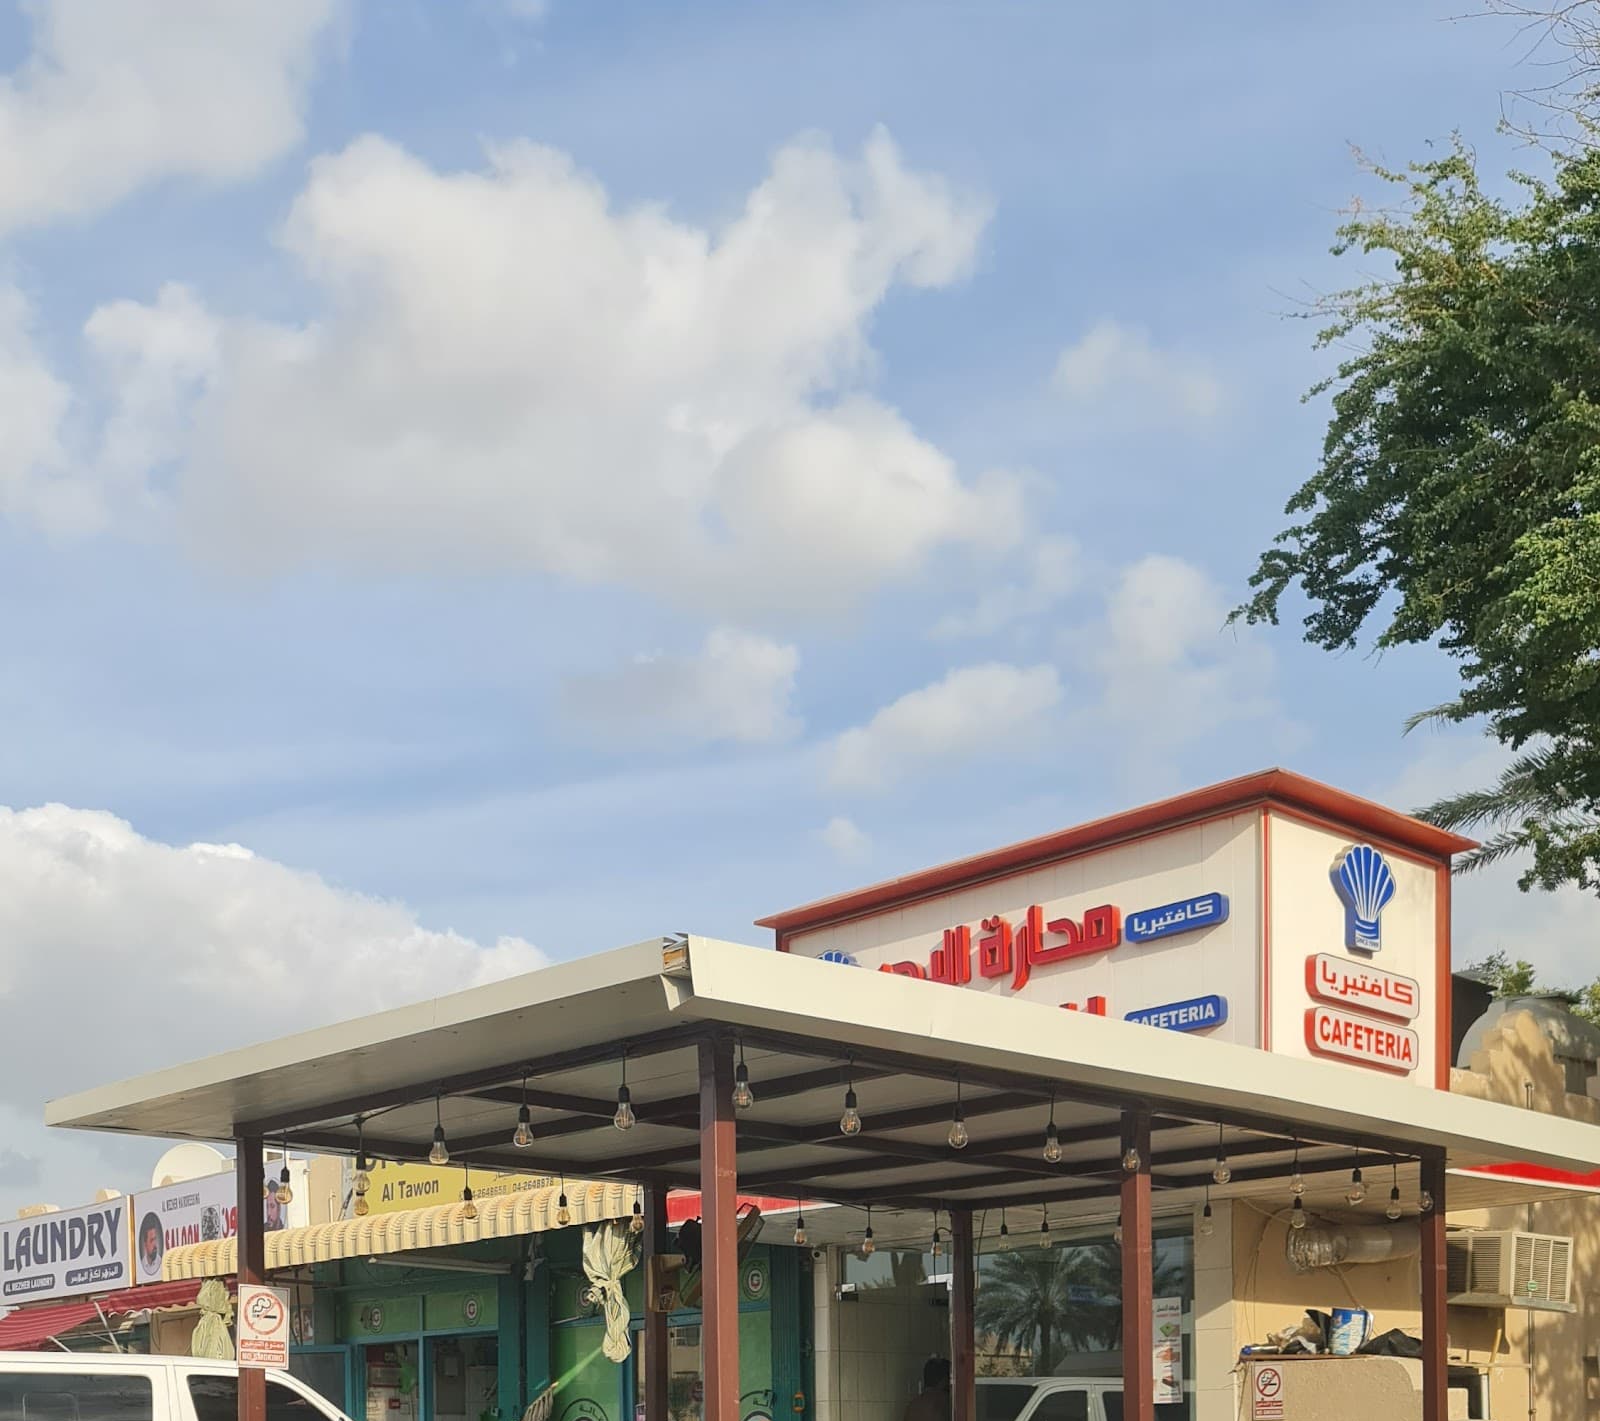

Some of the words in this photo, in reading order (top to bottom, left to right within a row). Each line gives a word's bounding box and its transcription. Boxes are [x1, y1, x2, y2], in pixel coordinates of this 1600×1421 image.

[1134, 899, 1213, 934] كافتيريا
[979, 903, 1121, 992] محارة
[1321, 960, 1413, 1005] كافتيريا
[1131, 1002, 1215, 1027] AFETERIA
[1319, 1015, 1412, 1063] CAFETERIA
[382, 1183, 394, 1202] Al
[398, 1179, 439, 1198] Tawon
[3, 1207, 122, 1273] LAUNDRY
[165, 1223, 200, 1250] SALOON
